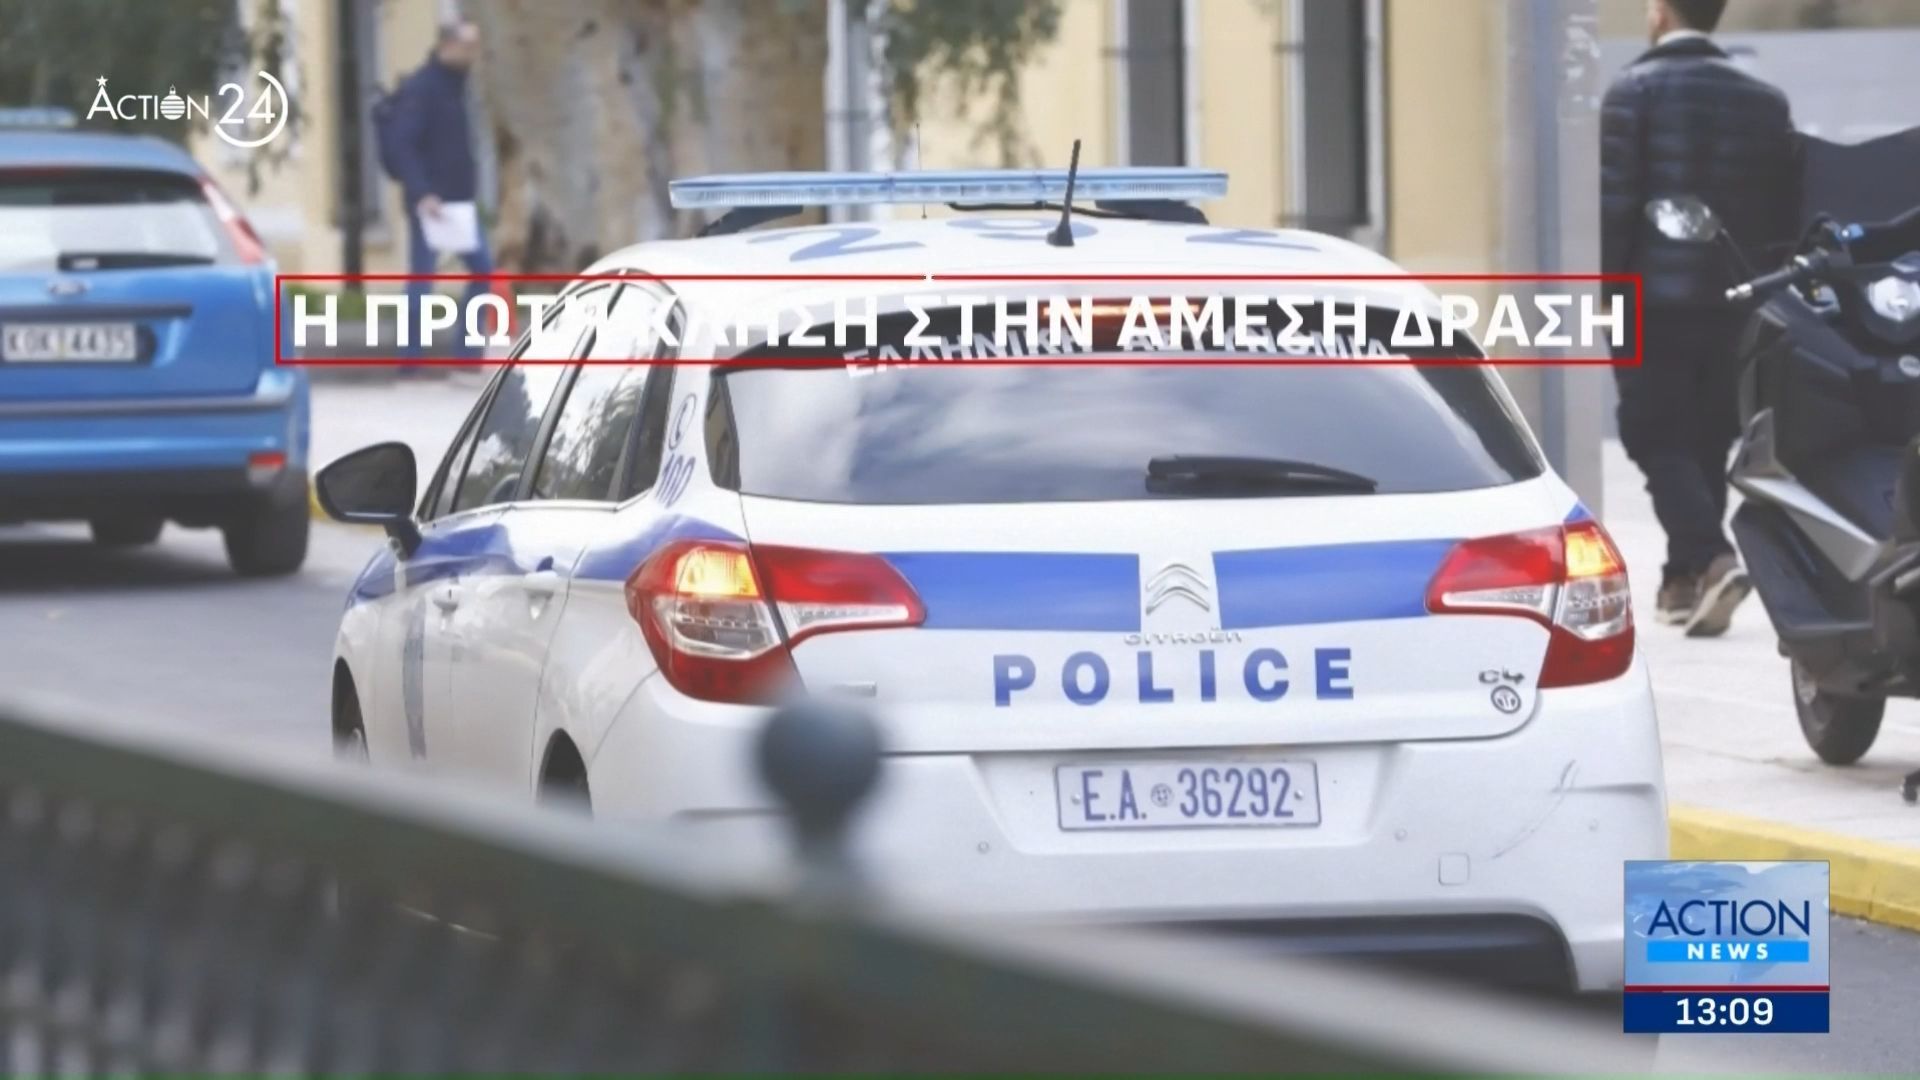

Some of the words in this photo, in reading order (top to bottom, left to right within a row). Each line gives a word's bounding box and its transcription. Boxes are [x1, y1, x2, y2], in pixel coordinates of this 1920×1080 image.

[993, 647, 1355, 707] POLICE
[1478, 666, 1526, 686] C4
[1177, 767, 1294, 819] 36292
